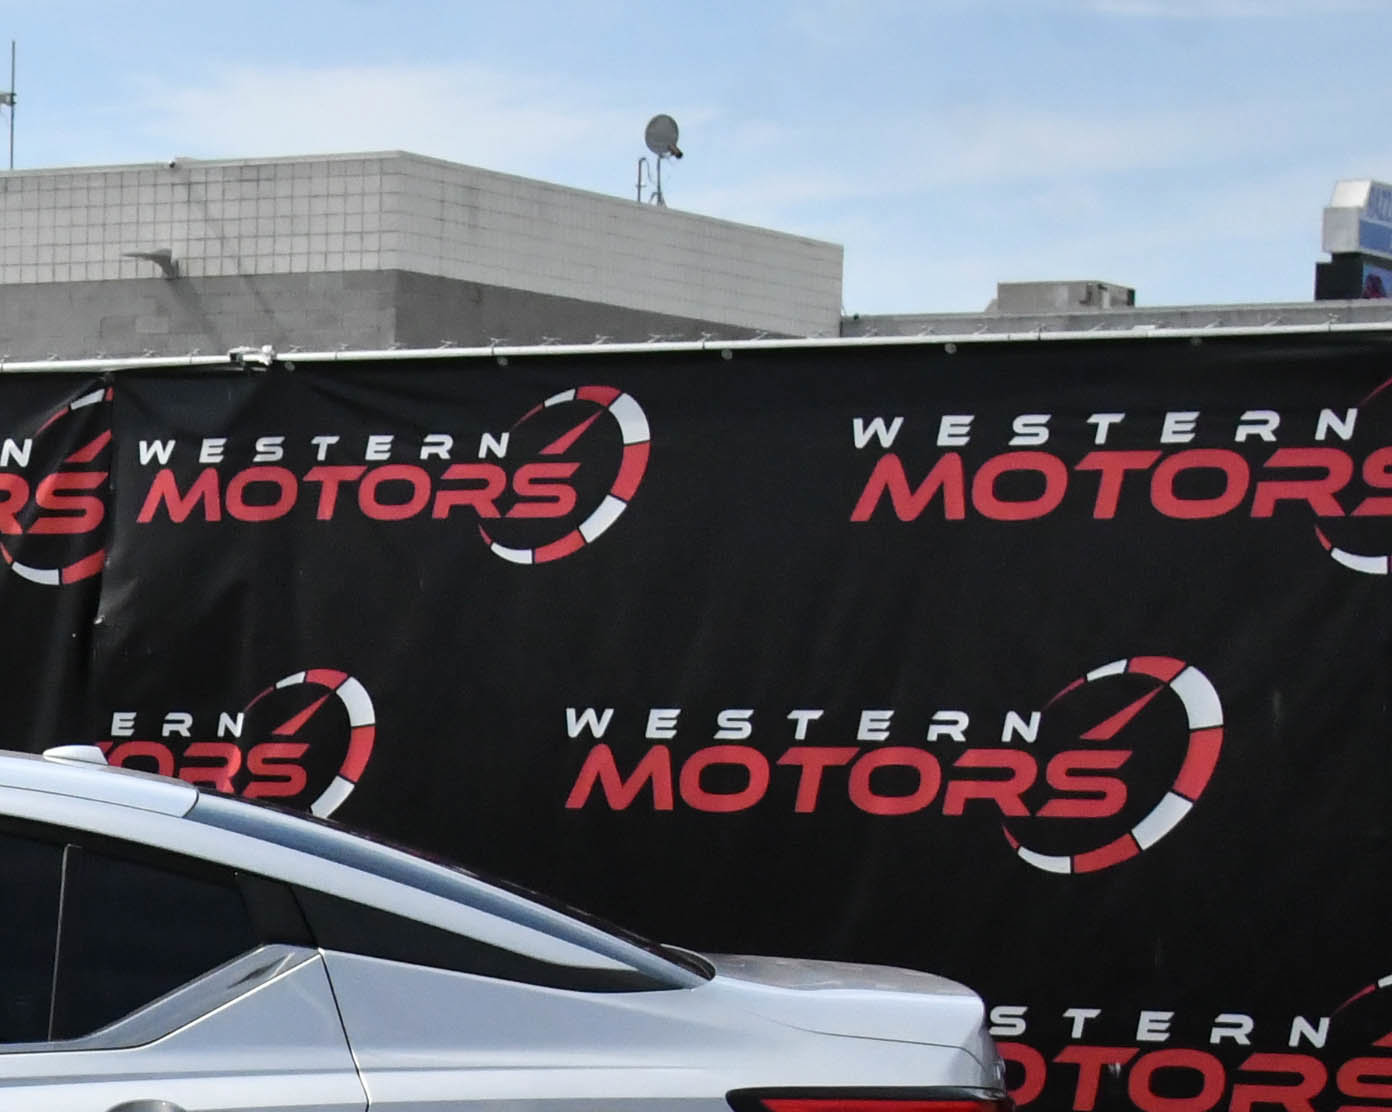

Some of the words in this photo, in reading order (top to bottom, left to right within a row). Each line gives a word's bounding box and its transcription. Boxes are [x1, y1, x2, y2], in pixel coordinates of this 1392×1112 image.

[853, 408, 1357, 448] WESTERN
[139, 432, 510, 465] WESTERN
[138, 462, 580, 523] MOTORS
[566, 708, 1041, 742] WESTERN
[568, 744, 1132, 818] MOTORS
